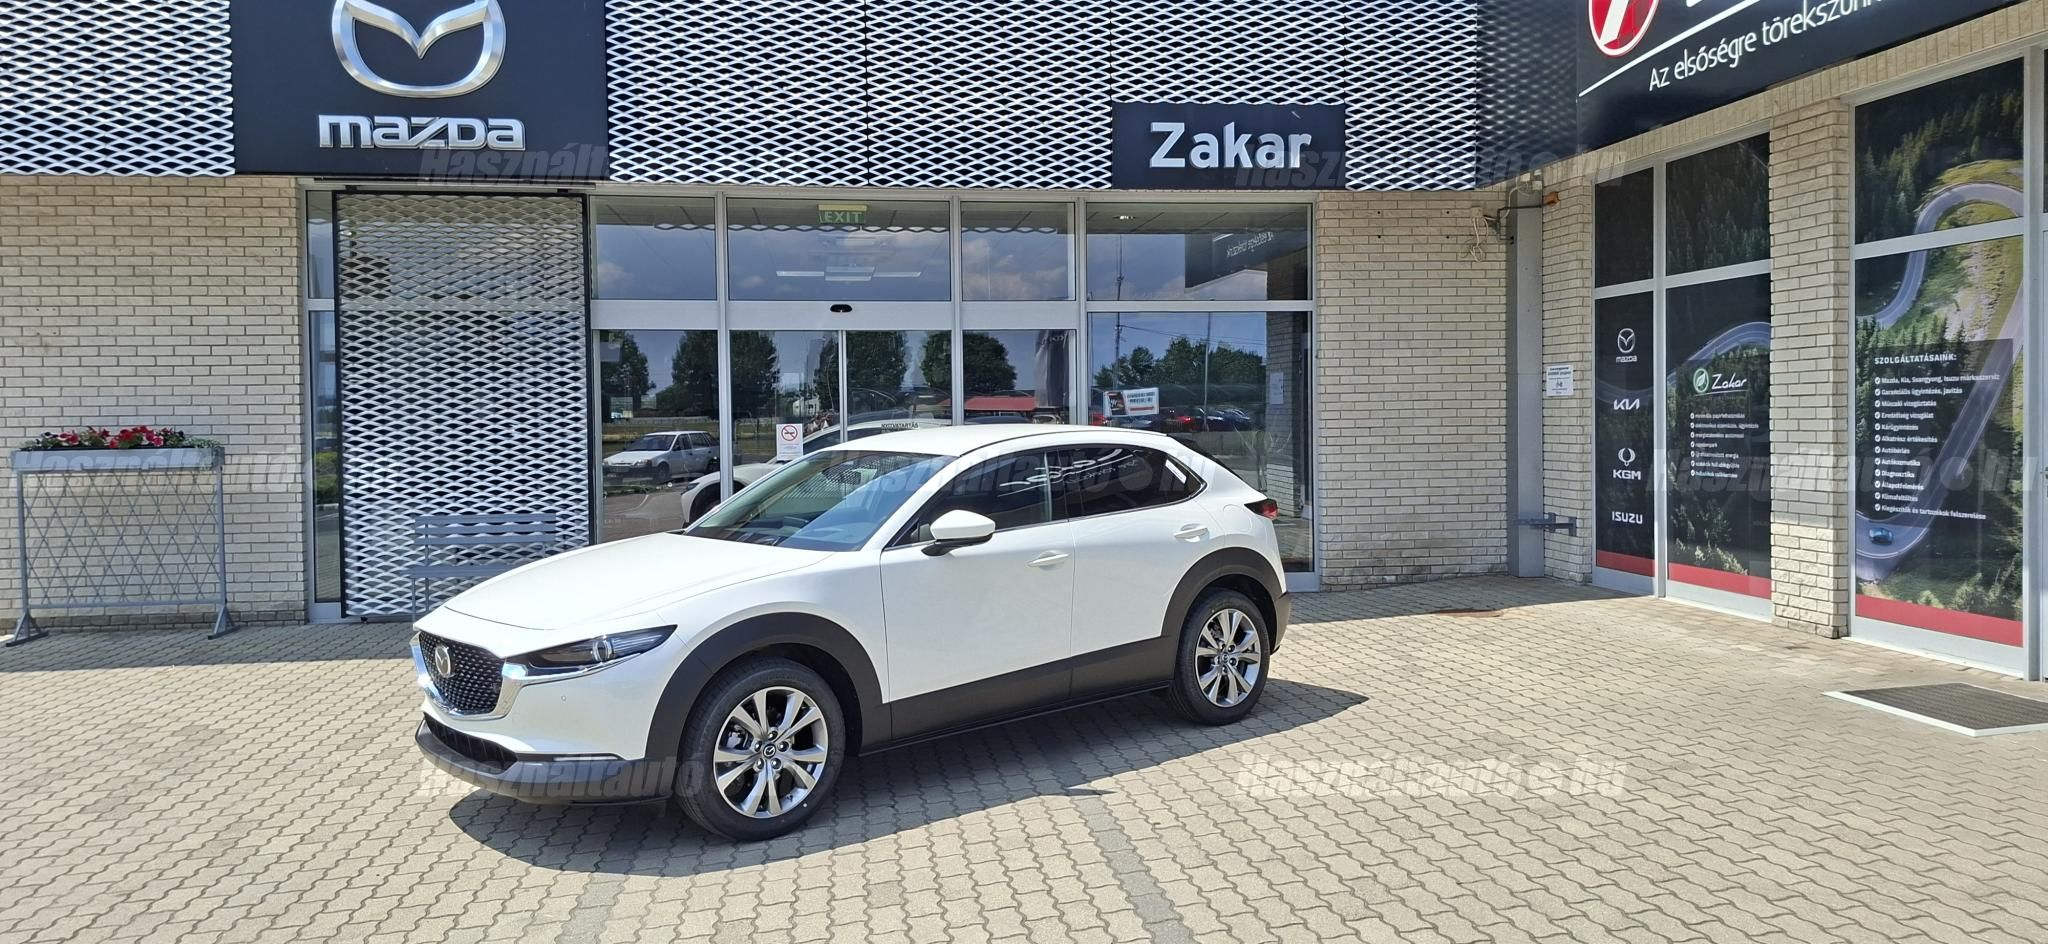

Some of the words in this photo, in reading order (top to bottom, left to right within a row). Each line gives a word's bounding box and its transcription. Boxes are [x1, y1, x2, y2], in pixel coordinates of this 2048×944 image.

[1649, 66, 1670, 92] Az
[1673, 30, 1757, 81] elsőségre
[1149, 121, 1313, 170] Zakar
[824, 211, 863, 224] EXIT
[1874, 352, 1957, 365] SZOLGÁLTATÁSAINK:
[1613, 398, 1640, 411] KIA
[1613, 469, 1641, 481] KGM
[1612, 511, 1643, 525] ISUZU
